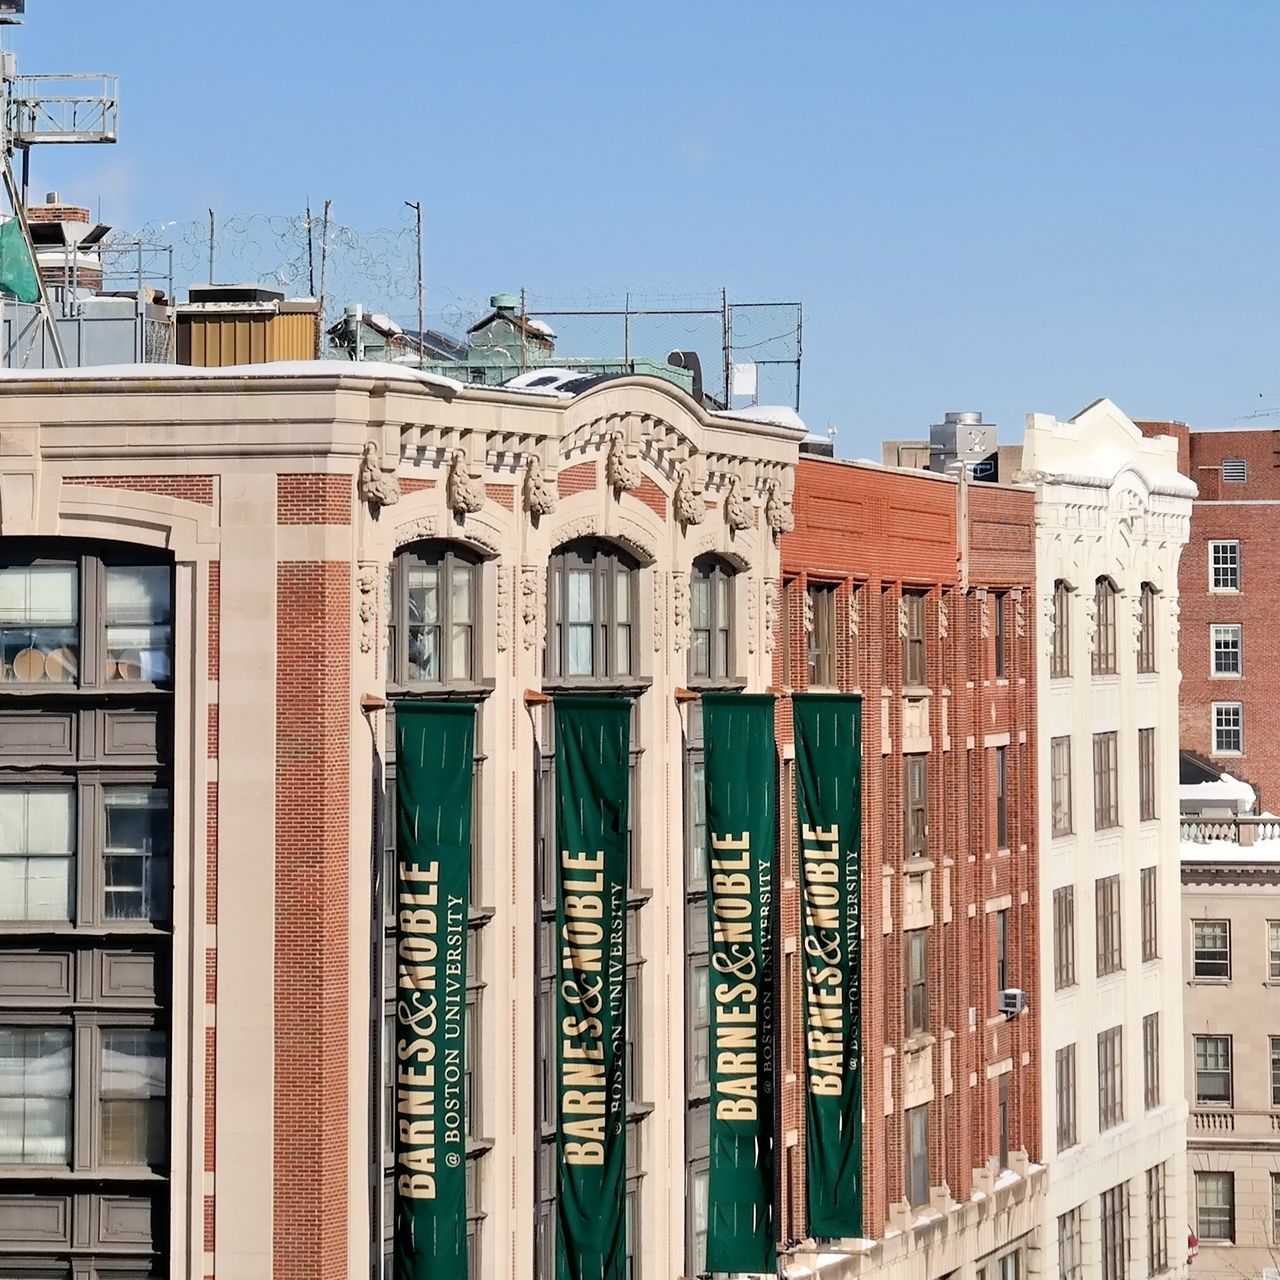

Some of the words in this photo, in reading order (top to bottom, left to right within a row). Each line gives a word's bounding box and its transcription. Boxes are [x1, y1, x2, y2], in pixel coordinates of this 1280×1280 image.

[445, 894, 464, 1040] UNIVERSITY
[608, 882, 624, 1018] UNIVERSITY
[758, 859, 773, 982] UNIVERSITY
[846, 850, 859, 969] UNIVERSITY
[763, 991, 773, 1072] BOSTON
[445, 1048, 461, 1144] BOSTON
[445, 1152, 461, 1168] @
